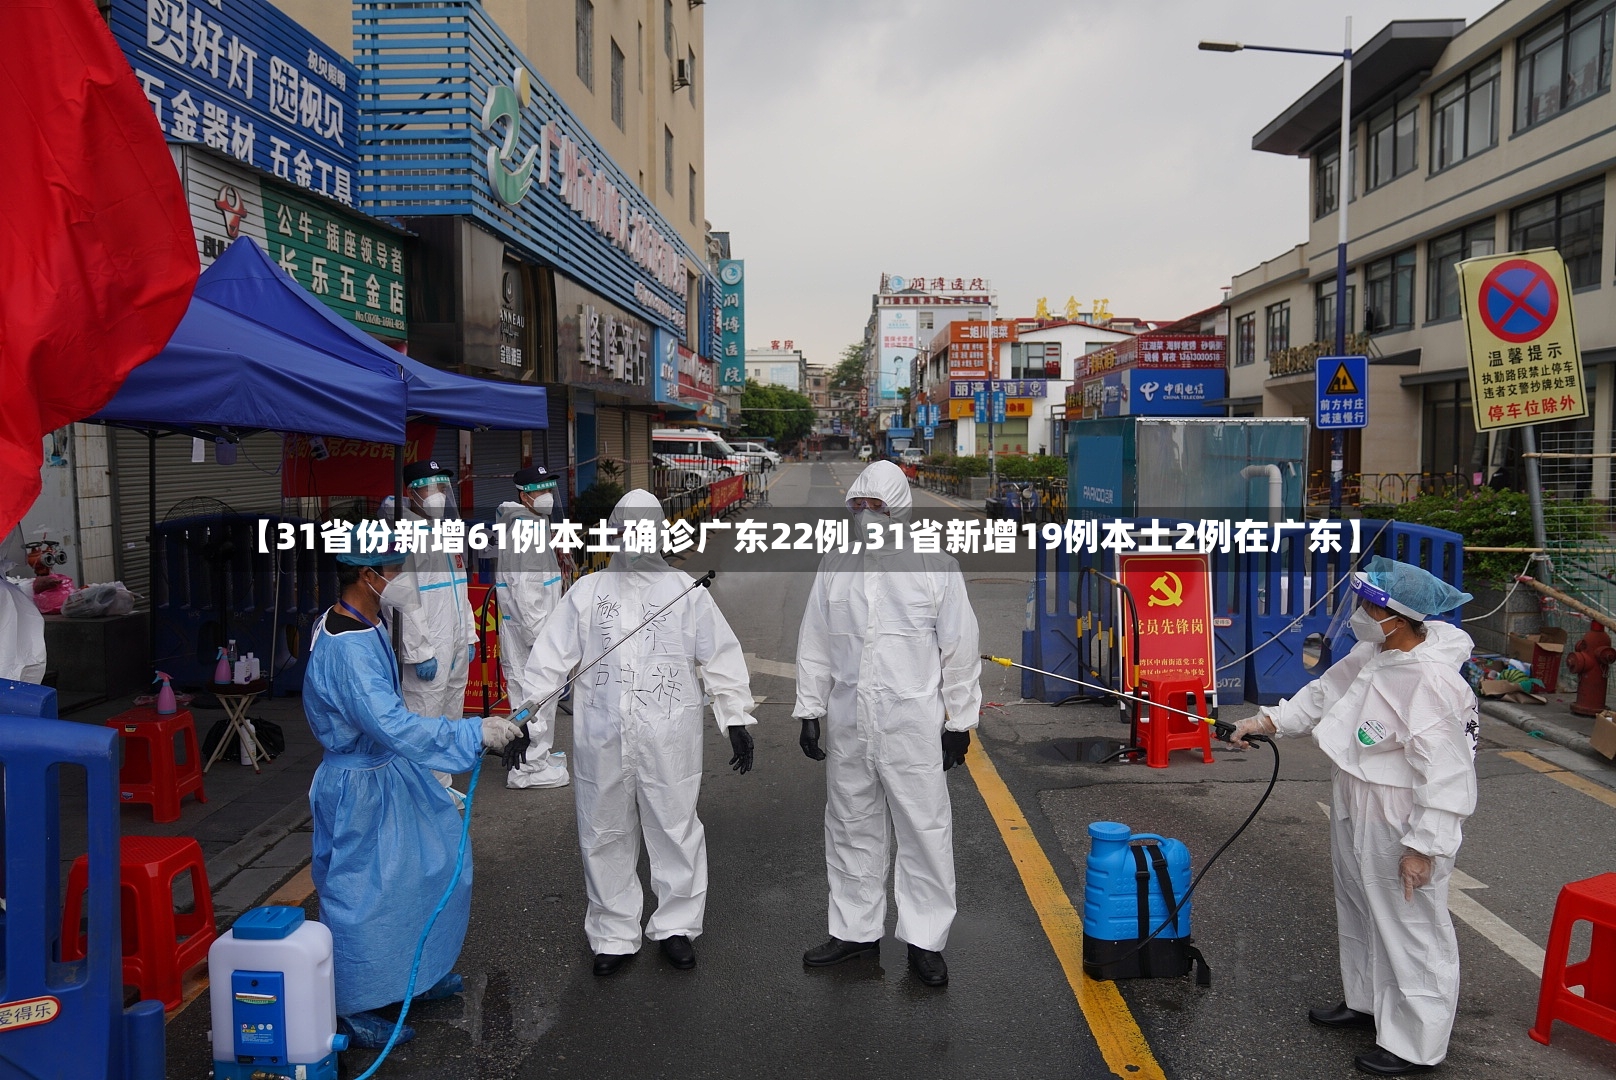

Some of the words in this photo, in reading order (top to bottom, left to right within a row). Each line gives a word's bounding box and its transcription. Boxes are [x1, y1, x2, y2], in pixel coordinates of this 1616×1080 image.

[307, 48, 346, 92] 视贝照明
[135, 68, 255, 165] 五金器材
[270, 135, 353, 207] 五金工具
[278, 244, 404, 315] 长乐五金店
[723, 293, 742, 383] 润博医院
[771, 340, 794, 349] 客房
[1488, 342, 1562, 367] 温馨提示
[1482, 361, 1574, 385] 执勤路段禁止停车
[1164, 383, 1204, 395] 中国电信
[1484, 375, 1576, 399] 违者交警抄牌处理
[1320, 398, 1365, 411] 前方村庄
[1488, 394, 1576, 422] 停车位除外
[1320, 412, 1365, 425] 减速慢行
[0, 1002, 52, 1026] 爱得乐
